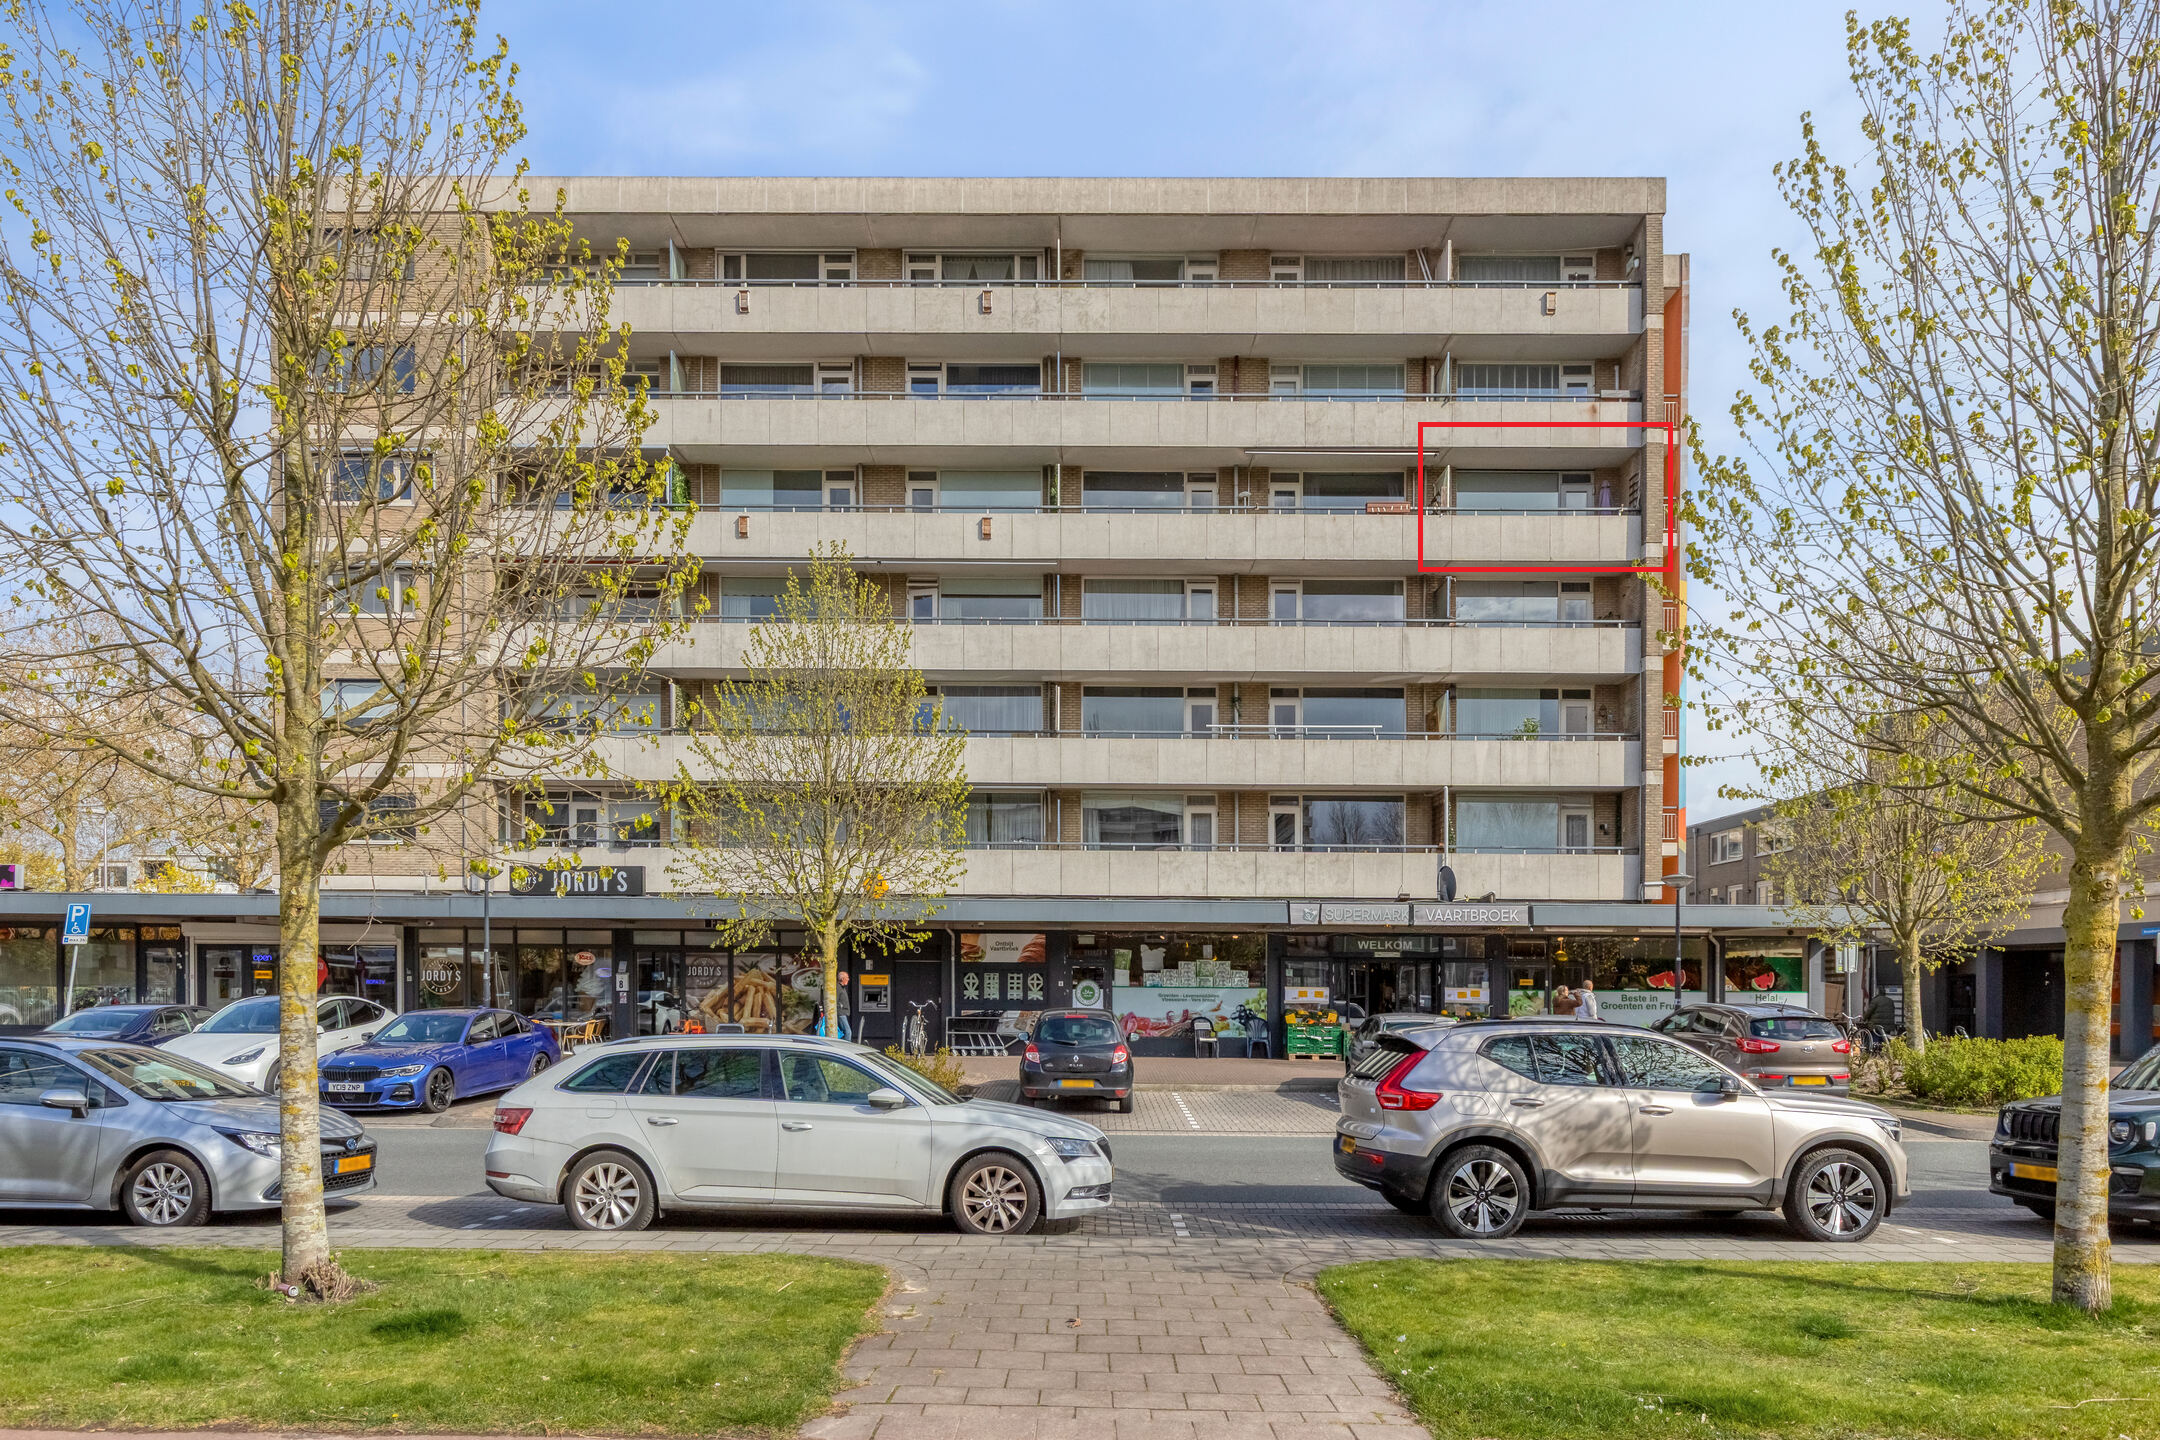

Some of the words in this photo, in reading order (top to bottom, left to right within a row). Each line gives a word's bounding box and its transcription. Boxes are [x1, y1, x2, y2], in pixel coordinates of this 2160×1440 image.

[551, 868, 628, 892] JORDY'S
[71, 905, 85, 922] P
[1325, 908, 1410, 921] SUPERMARK
[1426, 908, 1519, 922] VAARTBROEK
[1358, 940, 1413, 950] WELKOM
[421, 970, 461, 982] JORDYS
[687, 966, 722, 976] JORDYS
[618, 980, 624, 989] 8
[1621, 994, 1645, 1002] Beste
[1649, 994, 1658, 1002] in
[1600, 1001, 1644, 1010] Groenten
[1659, 1002, 1676, 1010] Fru
